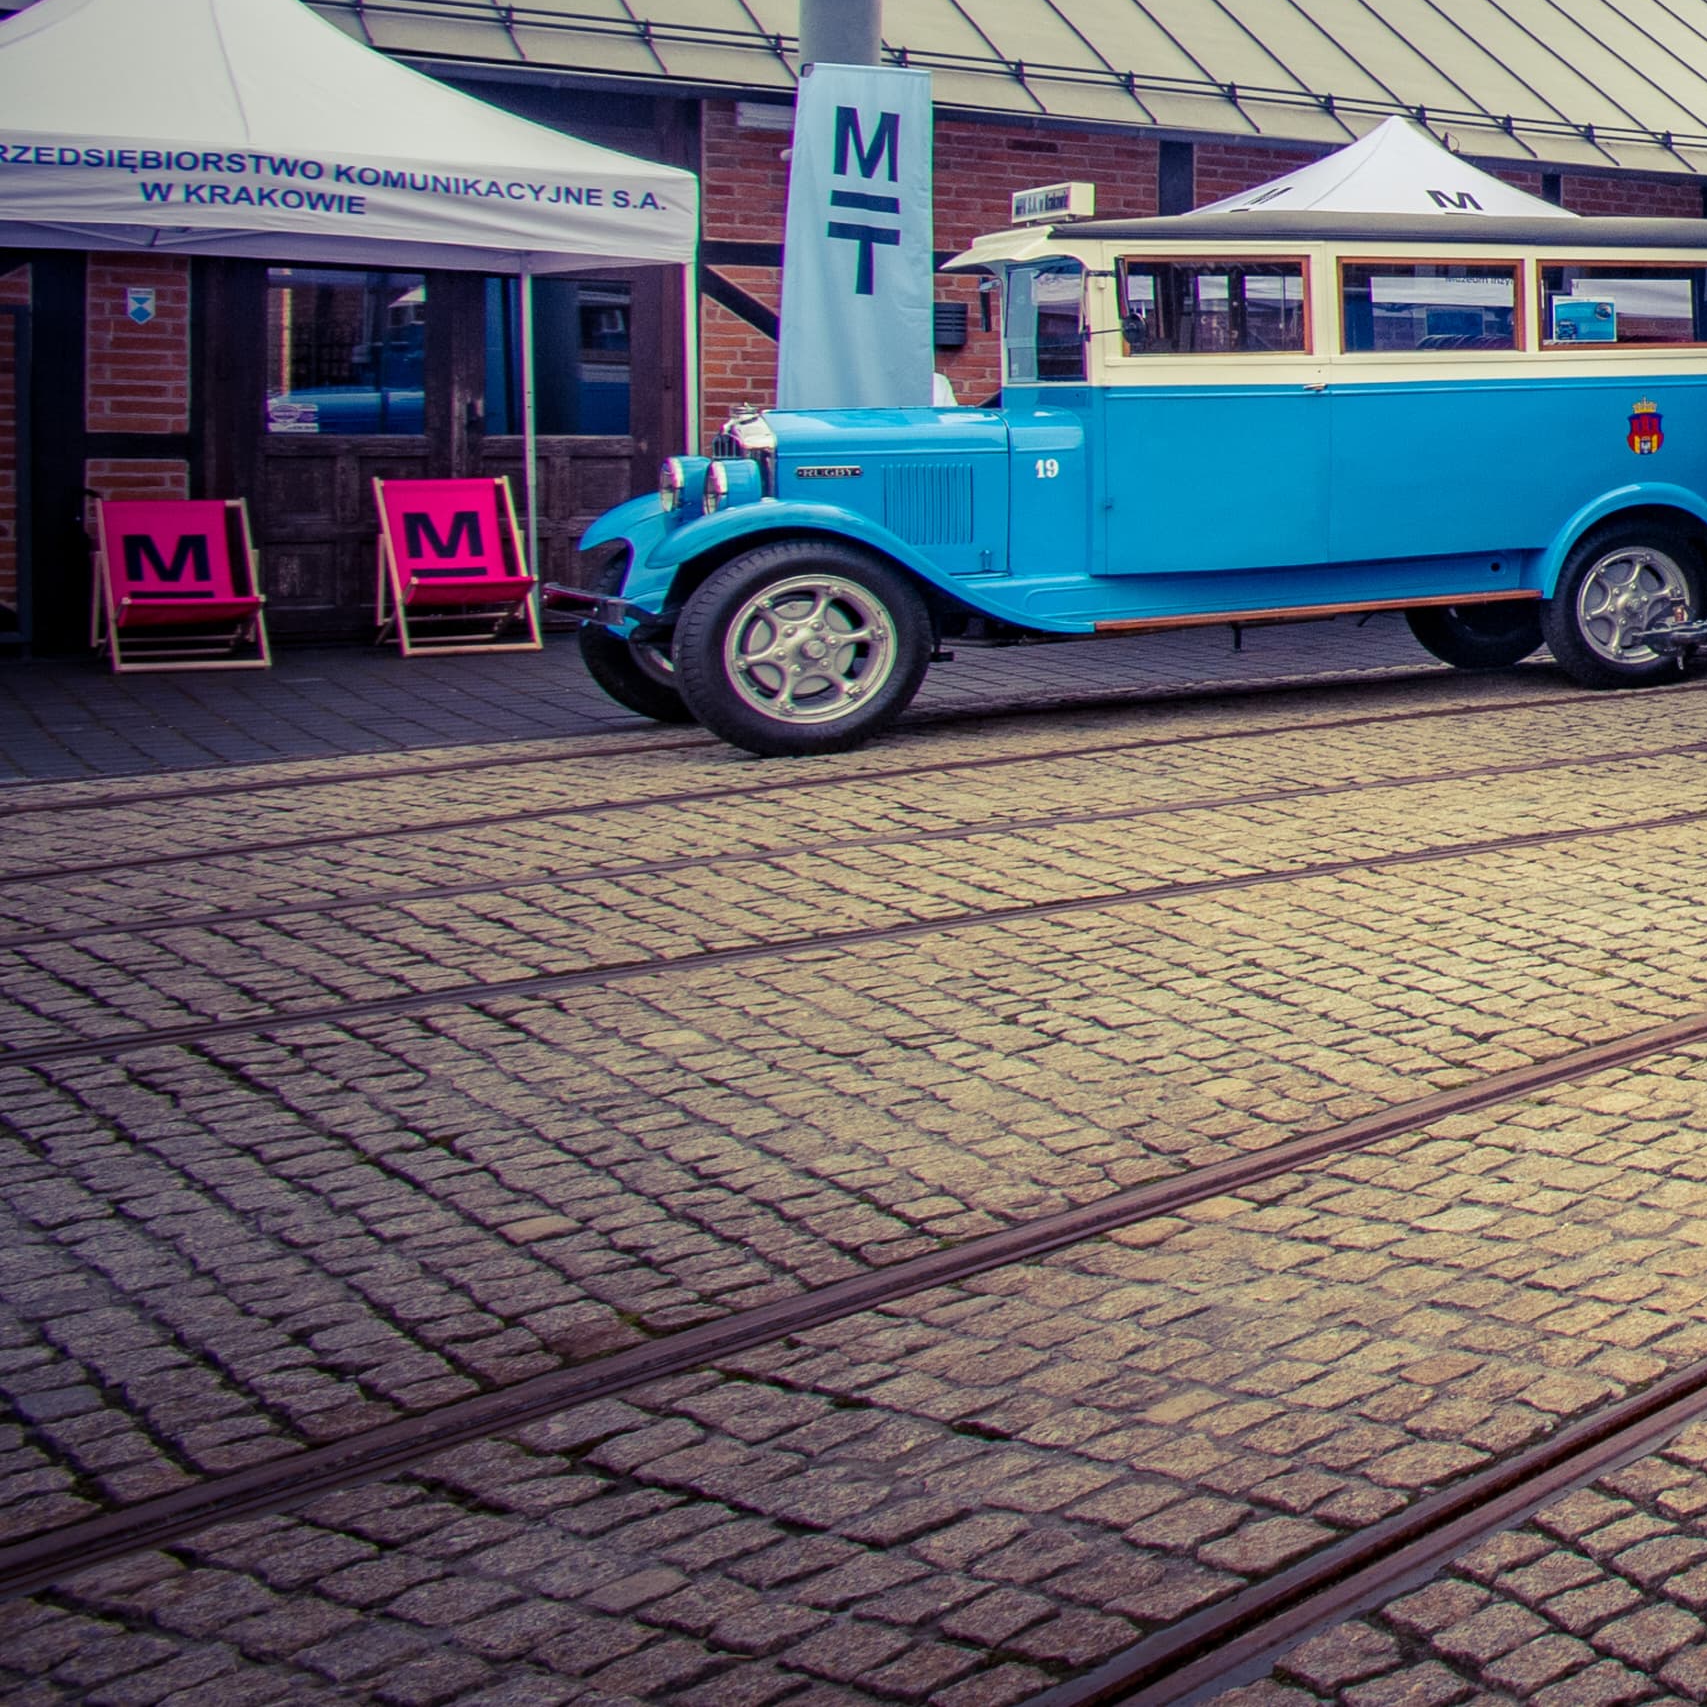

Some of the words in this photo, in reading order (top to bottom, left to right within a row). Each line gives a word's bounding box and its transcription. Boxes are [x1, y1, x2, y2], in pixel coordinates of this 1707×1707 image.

[834, 105, 900, 183] M
[139, 182, 173, 202] W
[184, 183, 367, 216] KRAKOWIE
[335, 163, 603, 207] KOMUNIKACYJNE
[612, 190, 667, 211] S.A.
[1426, 189, 1484, 211] M
[827, 220, 901, 296] T
[803, 468, 853, 477] RUGBY
[1035, 458, 1059, 479] 19
[122, 534, 211, 582] M
[402, 511, 485, 559] M
